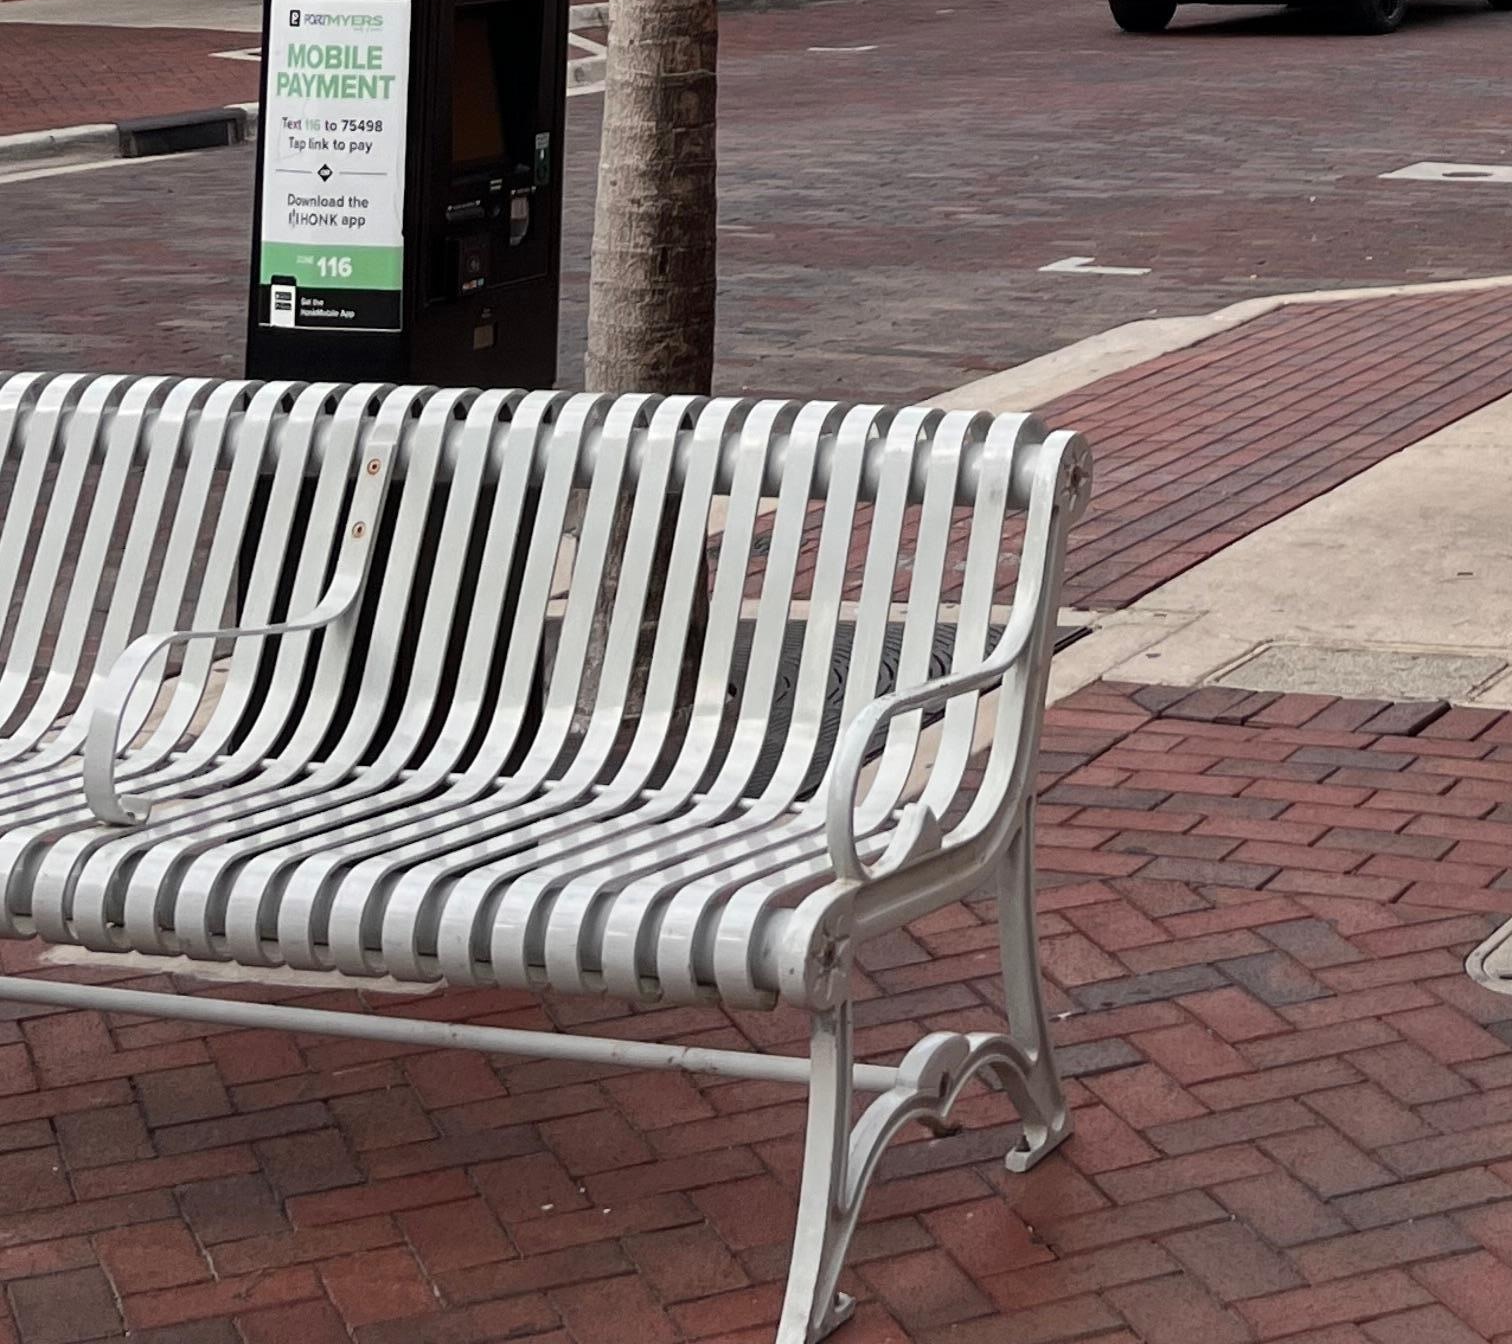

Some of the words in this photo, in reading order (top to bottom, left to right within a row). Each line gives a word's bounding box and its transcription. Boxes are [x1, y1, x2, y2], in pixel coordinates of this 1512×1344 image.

[287, 43, 383, 70] MOBILE
[276, 71, 396, 100] PAYMENT
[281, 116, 302, 130] Text
[325, 120, 338, 131] to
[341, 119, 383, 133] 75498
[289, 136, 306, 152] Tap
[308, 137, 329, 150] link
[333, 139, 346, 151] to
[349, 141, 373, 154] pay
[287, 193, 345, 208] Download
[348, 196, 370, 209] the
[341, 216, 366, 228] app
[316, 256, 353, 278] 116
